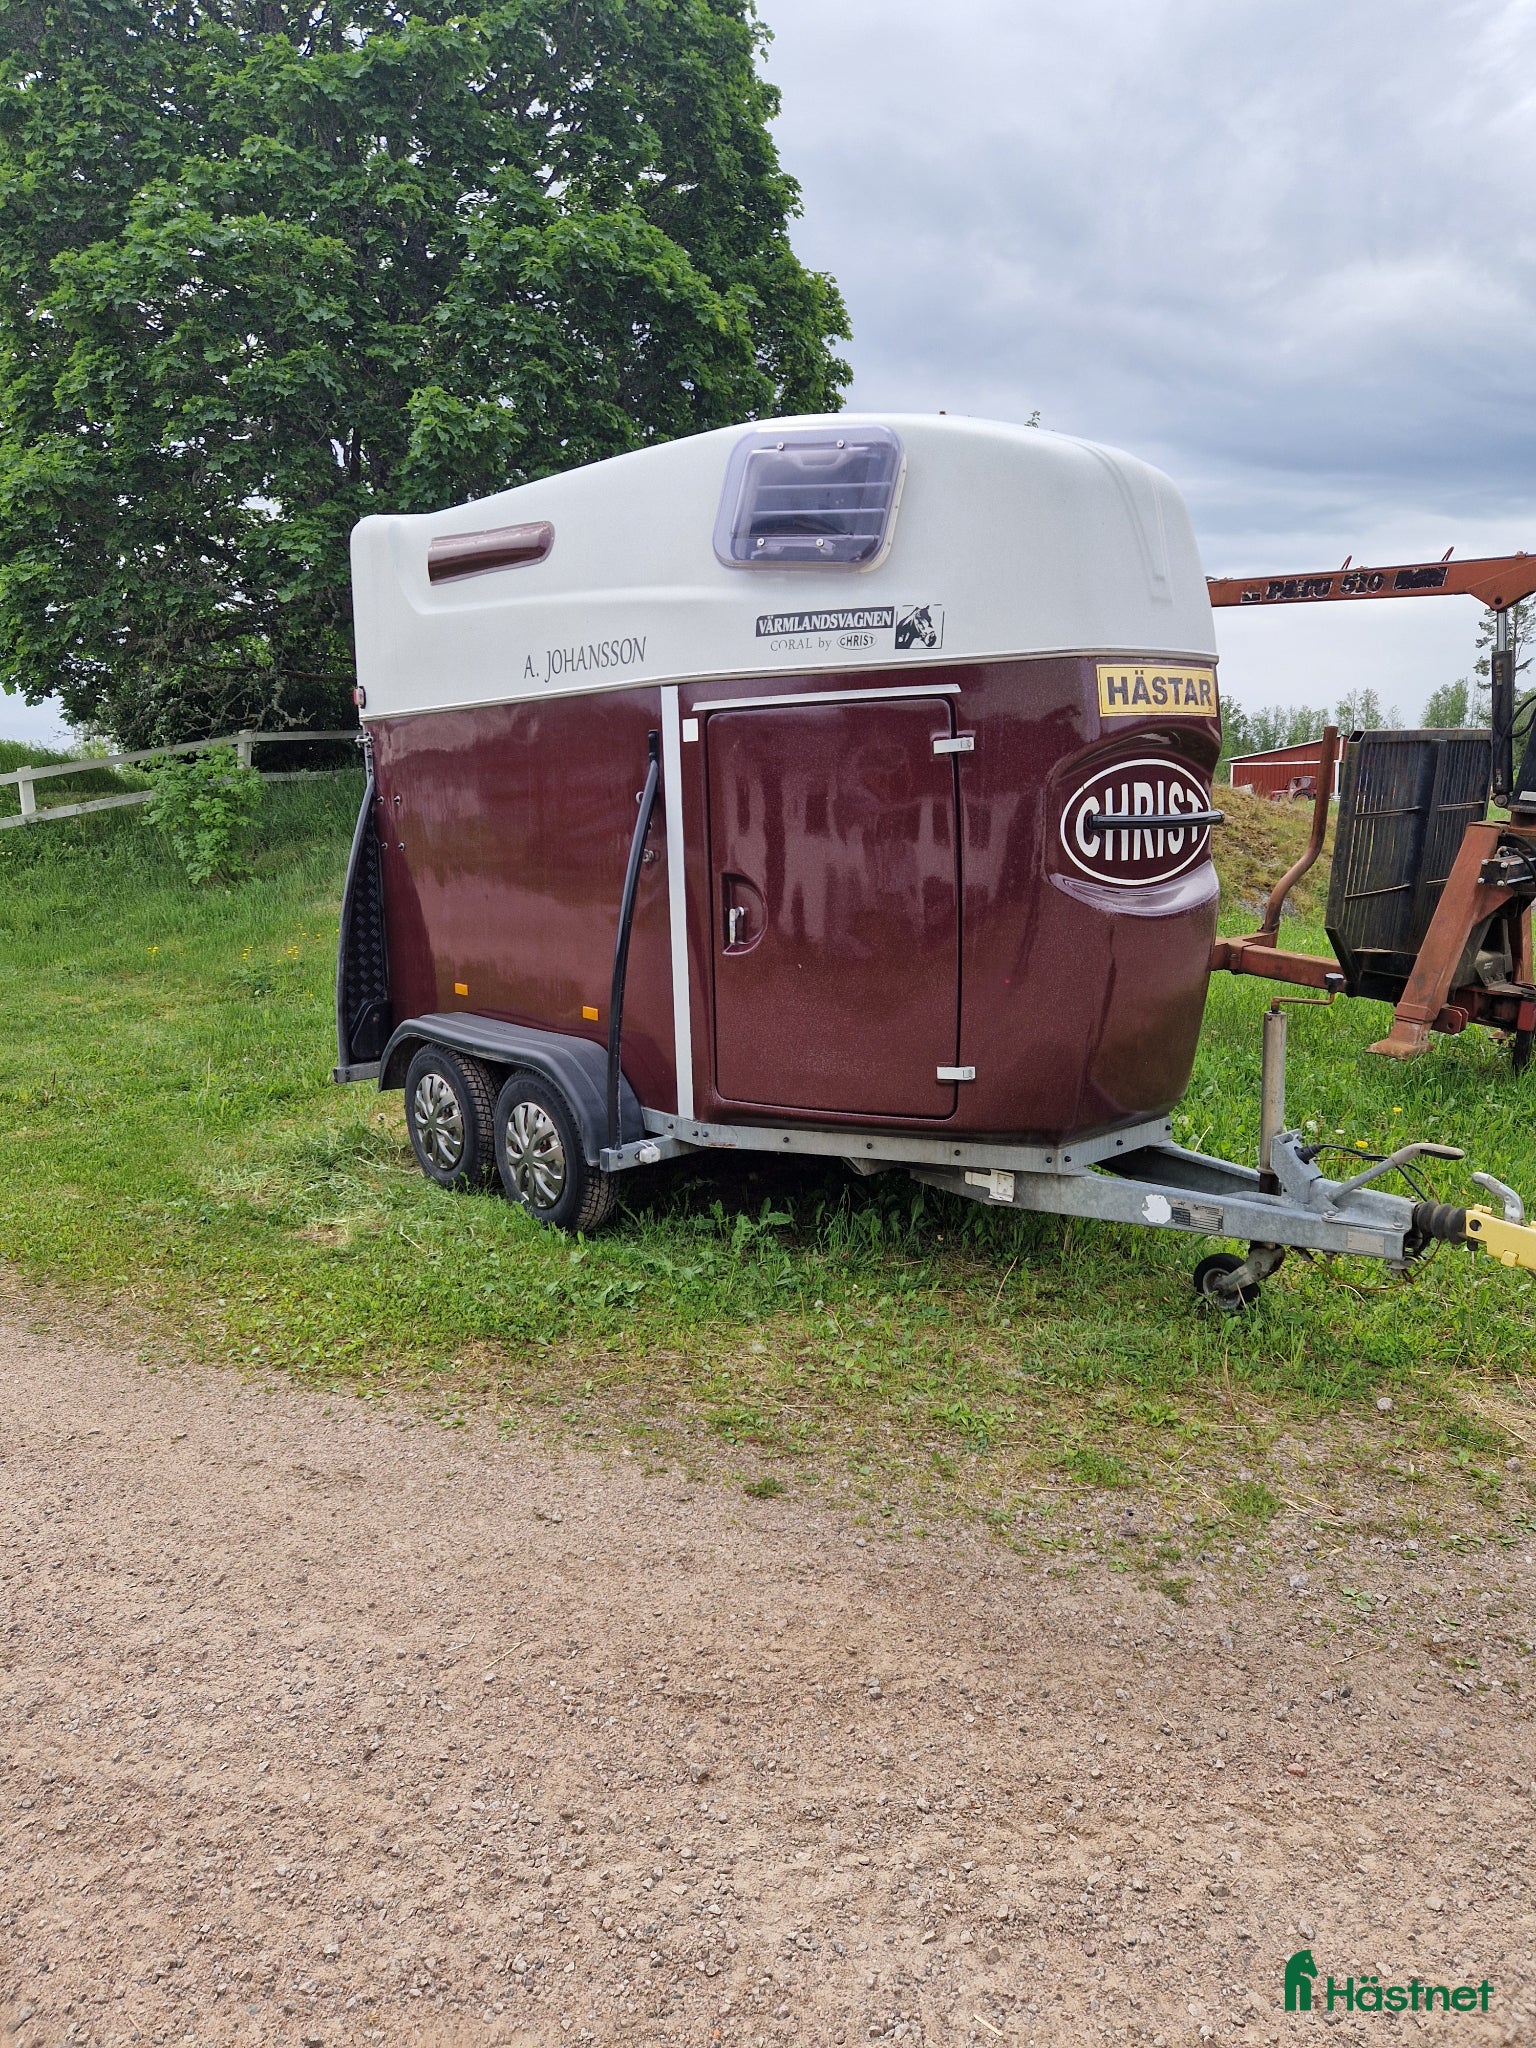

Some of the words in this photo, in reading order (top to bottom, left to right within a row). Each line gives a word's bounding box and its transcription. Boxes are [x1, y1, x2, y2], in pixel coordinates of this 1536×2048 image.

[758, 610, 893, 634] VÄRMLANDSVAGNEN
[524, 655, 539, 679] A.
[544, 636, 646, 683] JOHANSSON
[770, 638, 812, 652] CORAL
[818, 636, 831, 651] by
[839, 635, 874, 647] CHRIST
[1107, 670, 1214, 707] HÄSTAR
[1075, 780, 1204, 862] CHRIST
